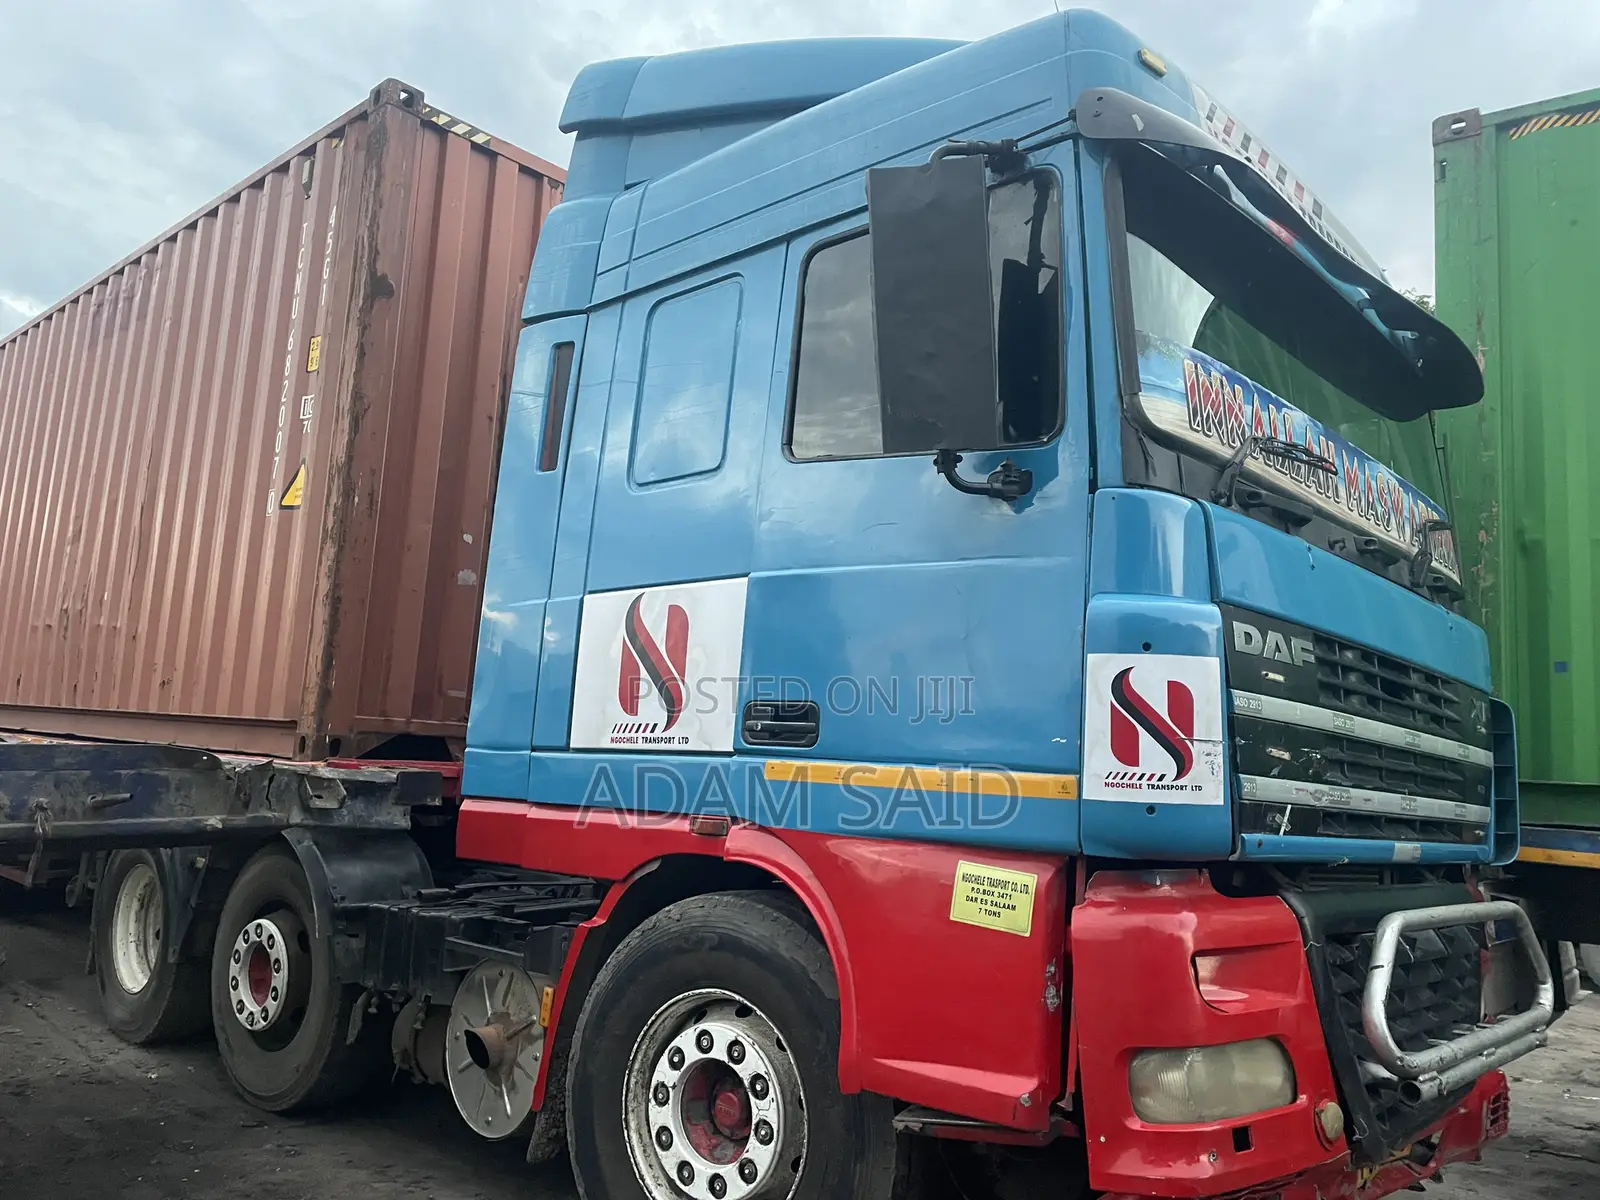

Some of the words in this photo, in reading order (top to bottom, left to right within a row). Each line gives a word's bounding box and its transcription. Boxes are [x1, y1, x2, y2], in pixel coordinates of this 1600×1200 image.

[321, 205, 337, 306] 45G1
[272, 328, 295, 479] 682007
[1232, 621, 1315, 667] DAF
[1249, 699, 1262, 710] 2913
[610, 736, 639, 745] NGOCHELE
[641, 736, 675, 745] TRANSPORT
[678, 736, 690, 745] LTD
[1104, 781, 1143, 790] NGOCHELE
[1147, 783, 1188, 791] TRANSPORT
[1191, 784, 1203, 792] LTD
[1243, 782, 1257, 793] 2913
[961, 872, 986, 886] NGOCHELE
[986, 877, 1011, 891] TRASPORT
[1010, 881, 1019, 893] CO.
[1020, 883, 1031, 895] LTD.
[996, 890, 1013, 901] 3471
[965, 895, 978, 904] DAR
[980, 898, 989, 906] ES
[990, 900, 1017, 912] SALAAM
[978, 907, 982, 915] 7
[984, 909, 1001, 919] TONS
